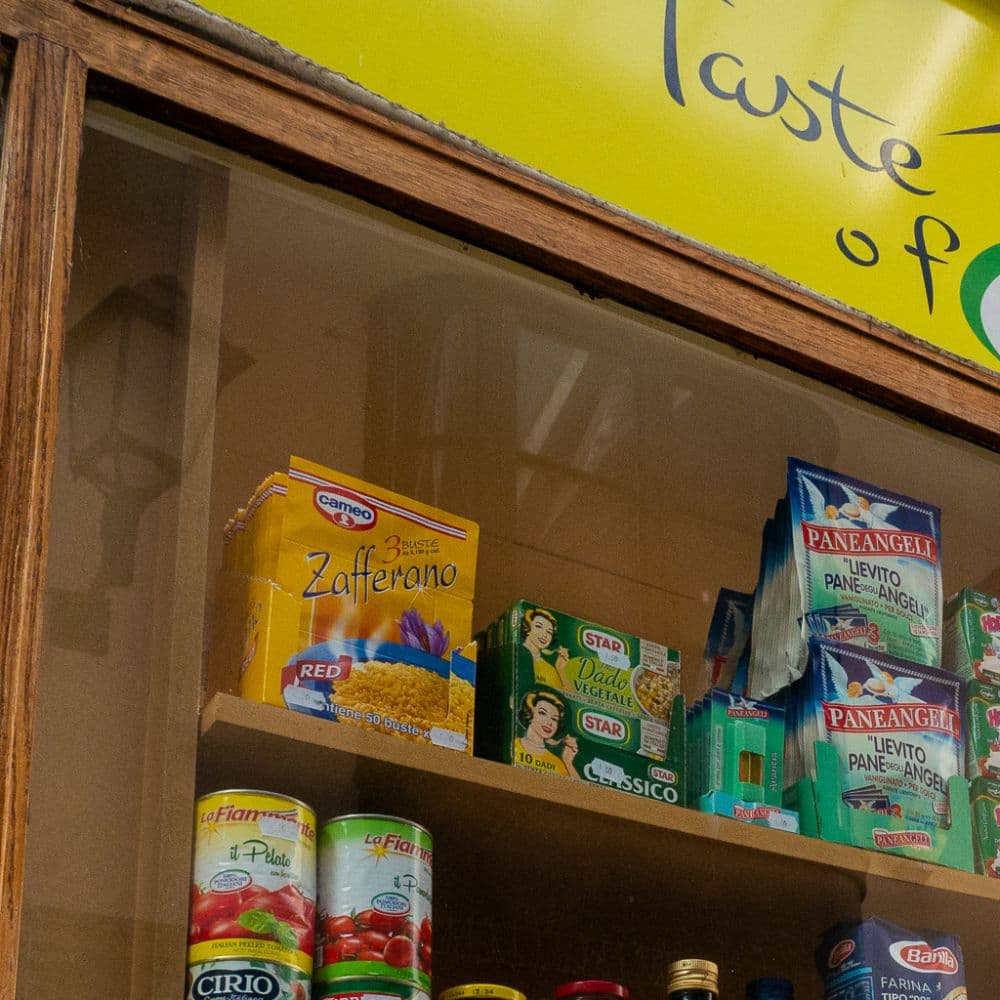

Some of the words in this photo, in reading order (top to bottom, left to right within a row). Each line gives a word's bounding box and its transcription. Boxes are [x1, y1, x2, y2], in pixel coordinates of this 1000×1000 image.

[664, 0, 936, 196] Taste
[837, 215, 959, 314] of
[318, 493, 372, 521] cameo
[382, 535, 402, 565] 3
[402, 539, 440, 550] BUSTE
[807, 529, 932, 559] PANEANGELI
[302, 545, 458, 605] Zafferano
[825, 573, 861, 593] PANE
[585, 632, 623, 653] STAR
[299, 663, 342, 679] RED
[579, 656, 628, 692] Dado
[574, 679, 634, 709] VEGETALE
[366, 713, 381, 725] 50
[384, 718, 420, 736] buste
[585, 716, 623, 738] STAR
[831, 707, 956, 732] PANEANGELI
[519, 752, 533, 765] 10
[535, 759, 556, 771] DADI
[849, 754, 887, 774] PANE
[652, 769, 674, 783] STAR
[200, 812, 216, 825] La
[365, 833, 383, 846] La
[230, 846, 240, 861] il
[243, 839, 292, 868] Pelato
[906, 948, 955, 969] Barilla
[196, 973, 273, 996] CIRIO
[880, 976, 933, 993] FARINA
